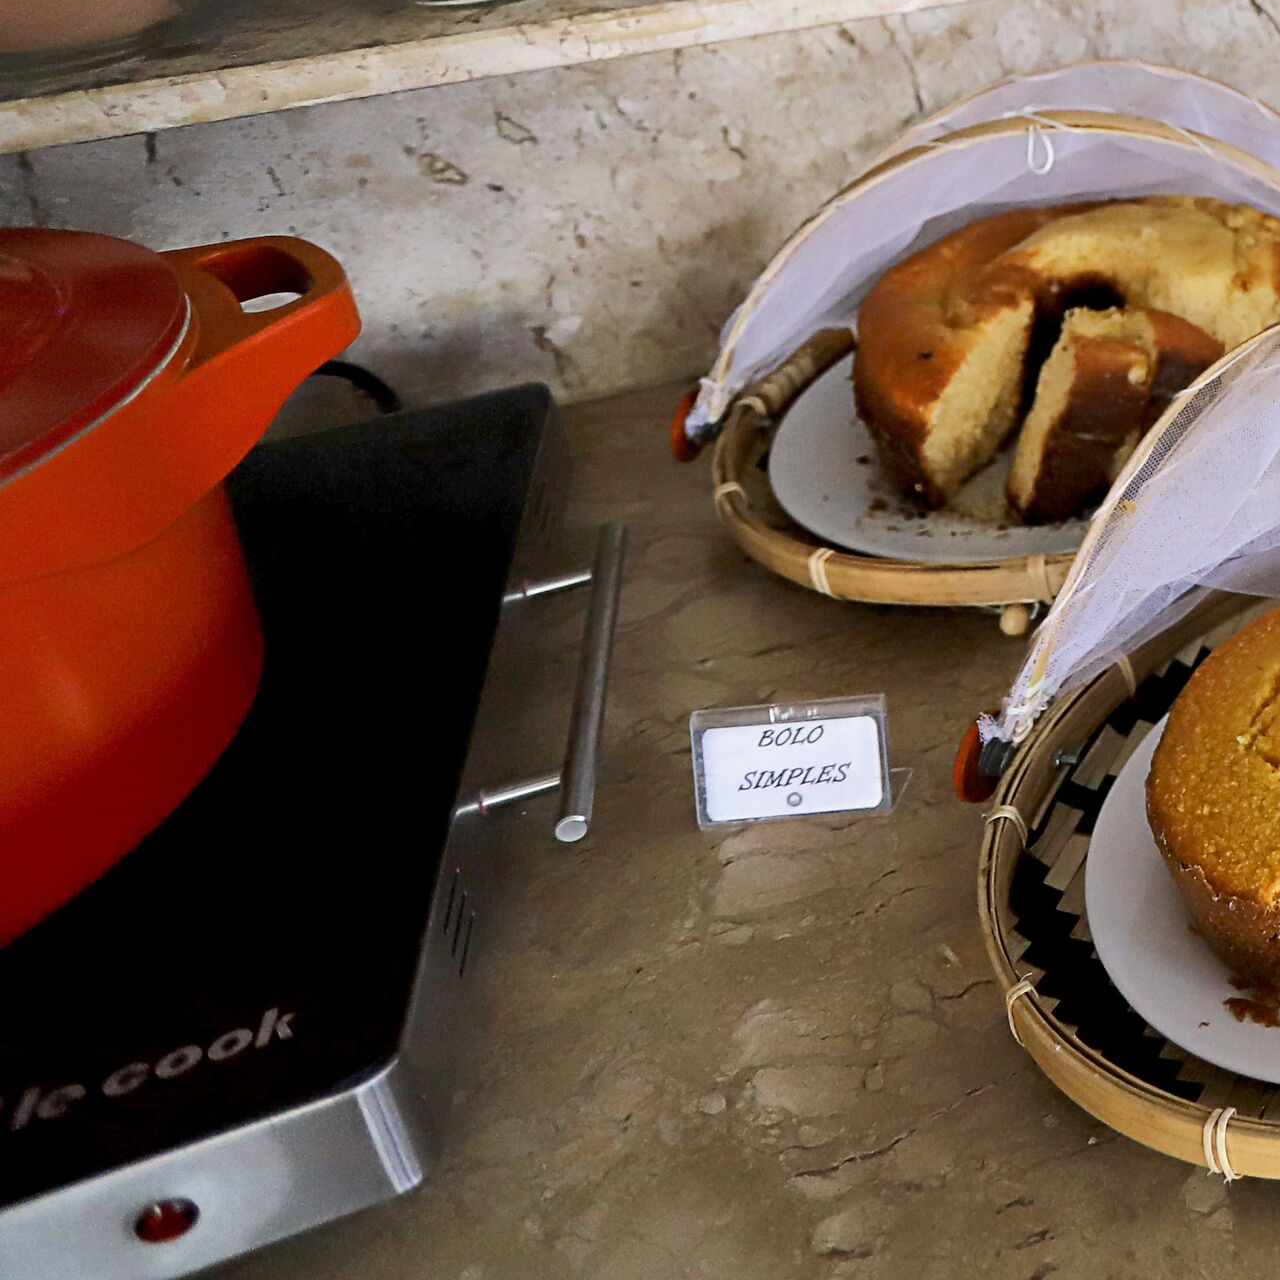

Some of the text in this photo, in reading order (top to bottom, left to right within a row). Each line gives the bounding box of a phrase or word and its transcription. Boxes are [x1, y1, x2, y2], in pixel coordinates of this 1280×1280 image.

[757, 724, 824, 748] BOLO
[737, 761, 852, 792] SIMPLES
[101, 1005, 297, 1098] cook
